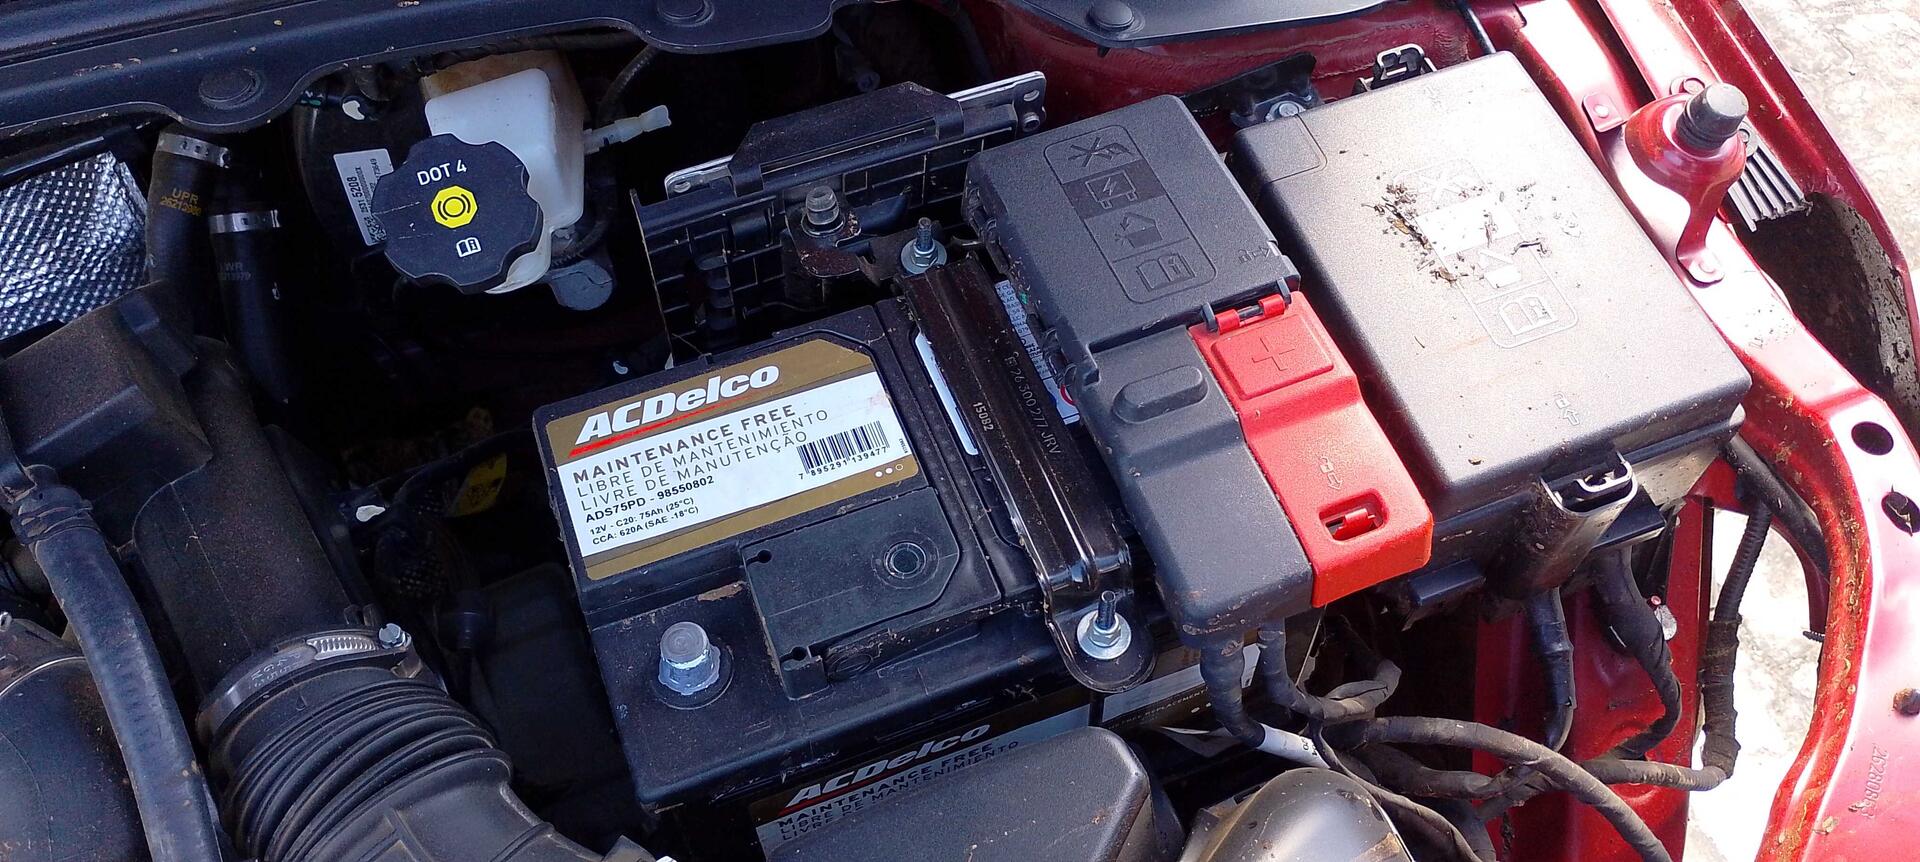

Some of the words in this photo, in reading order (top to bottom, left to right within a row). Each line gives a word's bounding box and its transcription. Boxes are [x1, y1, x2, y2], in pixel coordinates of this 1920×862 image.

[171, 187, 199, 205] UPR
[346, 176, 363, 198] 5208
[417, 163, 450, 186] DOT
[456, 159, 467, 173] 4
[574, 365, 779, 446] ACDelco
[573, 424, 733, 484] MAINTENANCE
[740, 404, 796, 431] FREE
[577, 471, 634, 498] LIBRE
[641, 460, 666, 478] DE
[672, 409, 828, 468] MANTENIMIENTO
[852, 446, 887, 463] 139477
[1041, 431, 1061, 453] JRV
[581, 484, 638, 511] LIVRE
[645, 474, 670, 491] DE
[677, 431, 807, 481] MANUTENÇÃO
[586, 497, 646, 523] ADS75PD
[657, 475, 714, 500] 98550802
[590, 524, 607, 535] 12V
[615, 516, 637, 527] C20:
[640, 507, 664, 520] 75Ah
[665, 497, 694, 511] (25°C)
[592, 533, 617, 545] CCA:
[619, 523, 644, 537] 620A
[645, 516, 668, 530] (SAE
[671, 506, 699, 520] -18°C)
[778, 765, 932, 827] MAINTENANCE
[941, 742, 993, 767] FREE
[780, 810, 833, 834] LIBRE
[841, 799, 863, 813] DE
[871, 741, 1019, 803] MANTENIMIENTO
[784, 724, 991, 808] ACDelco
